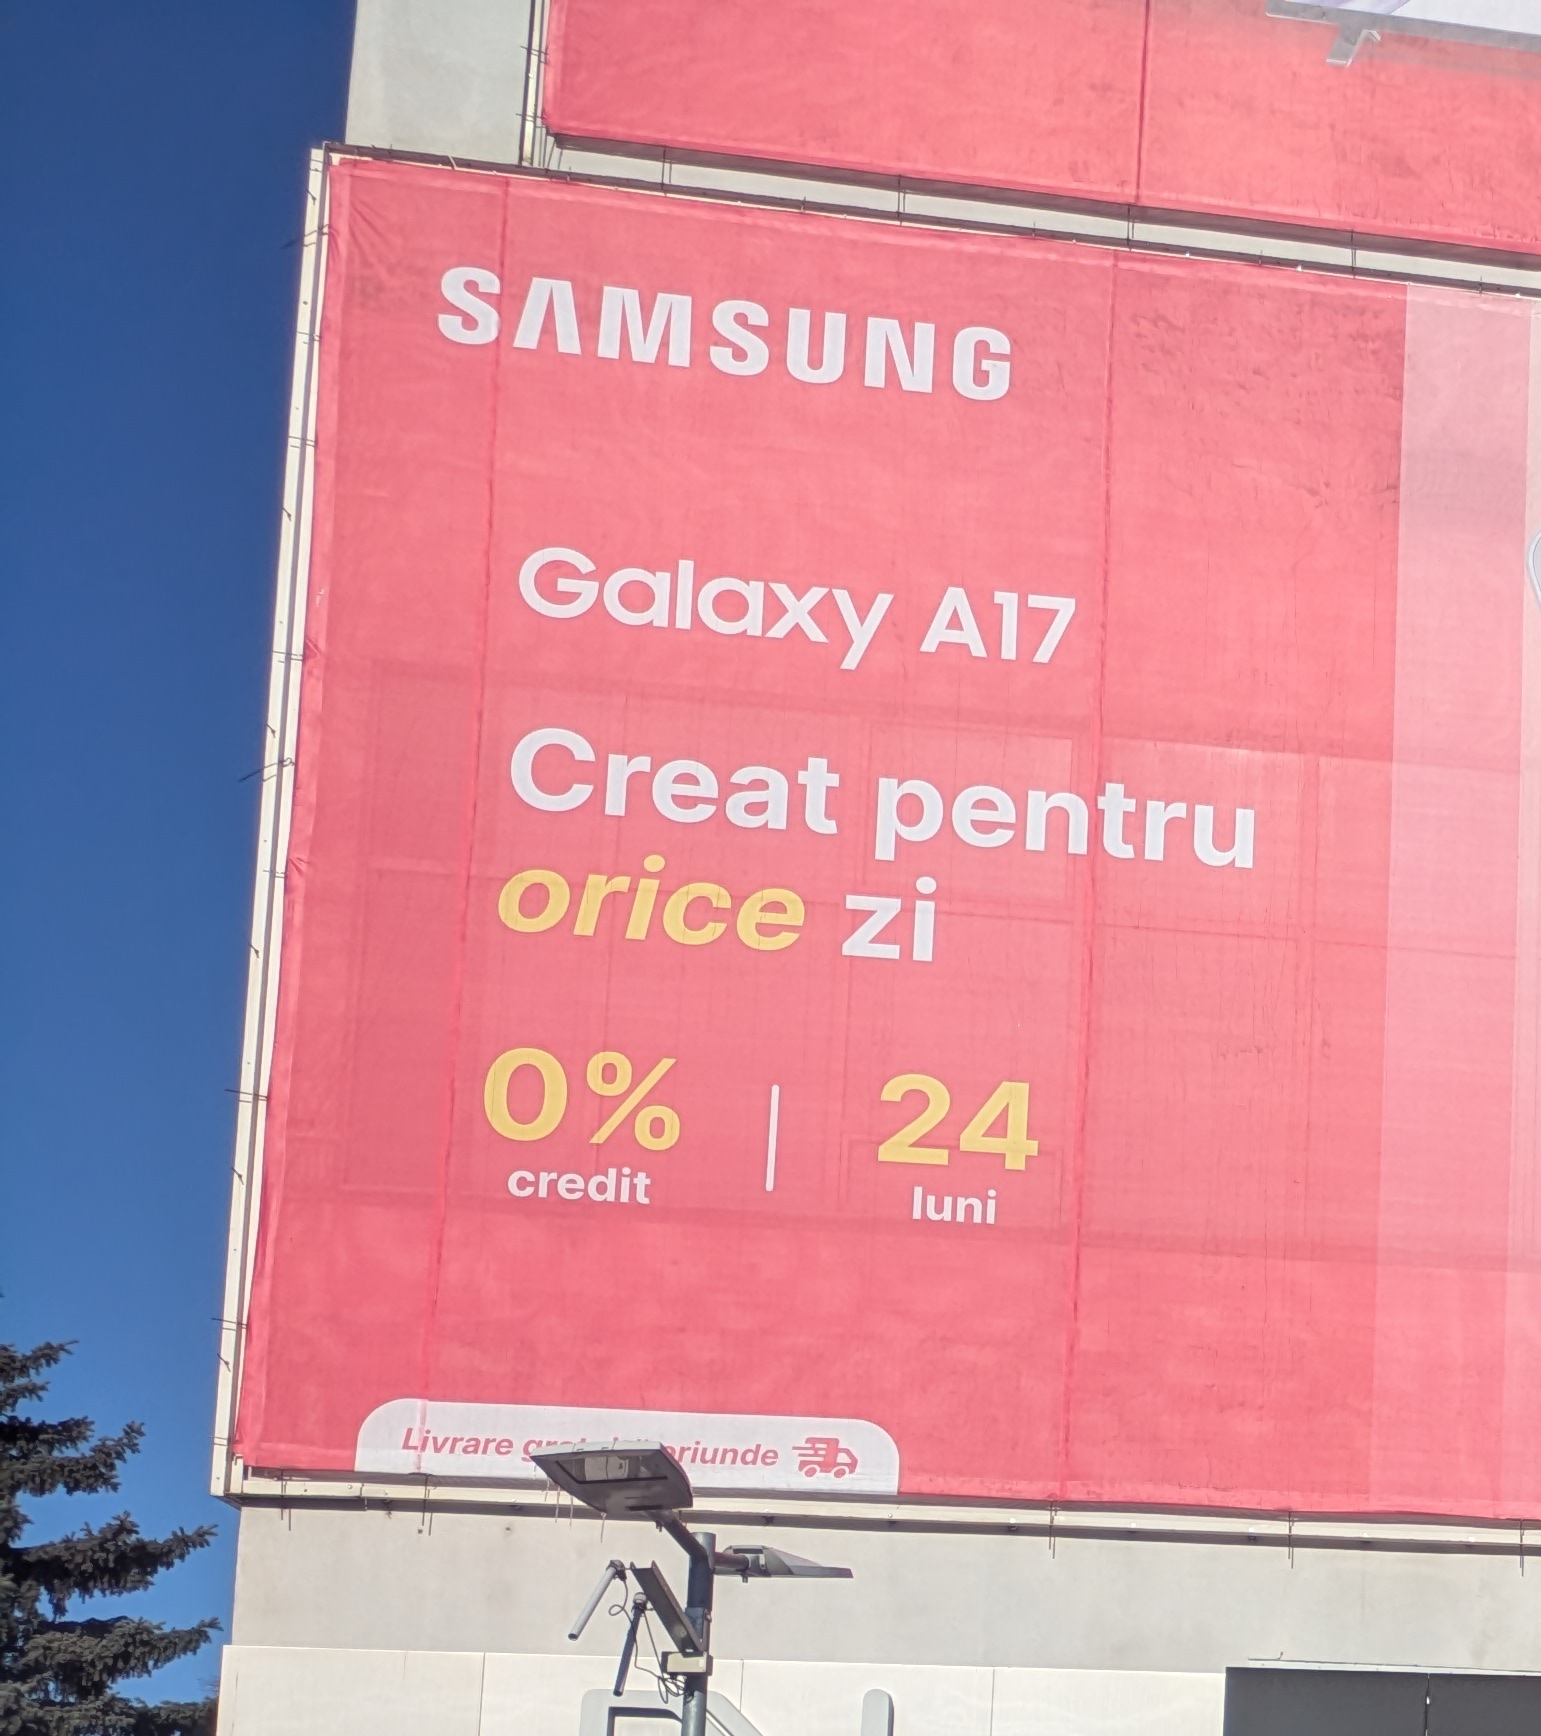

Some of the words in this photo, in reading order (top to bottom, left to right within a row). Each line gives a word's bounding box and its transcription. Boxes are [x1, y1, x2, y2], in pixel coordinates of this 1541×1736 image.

[438, 266, 1011, 401] SAMSUNG
[518, 546, 894, 670] Galaxy
[920, 587, 1075, 664] A17
[510, 728, 839, 834] Creat
[875, 774, 1255, 868] pentru
[498, 854, 805, 951] orice
[841, 876, 937, 964] zi
[483, 1047, 680, 1152] 0%
[877, 1073, 1039, 1171] 24
[507, 1165, 652, 1204] credit
[911, 1187, 998, 1224] luni
[402, 1427, 513, 1457] Livrare
